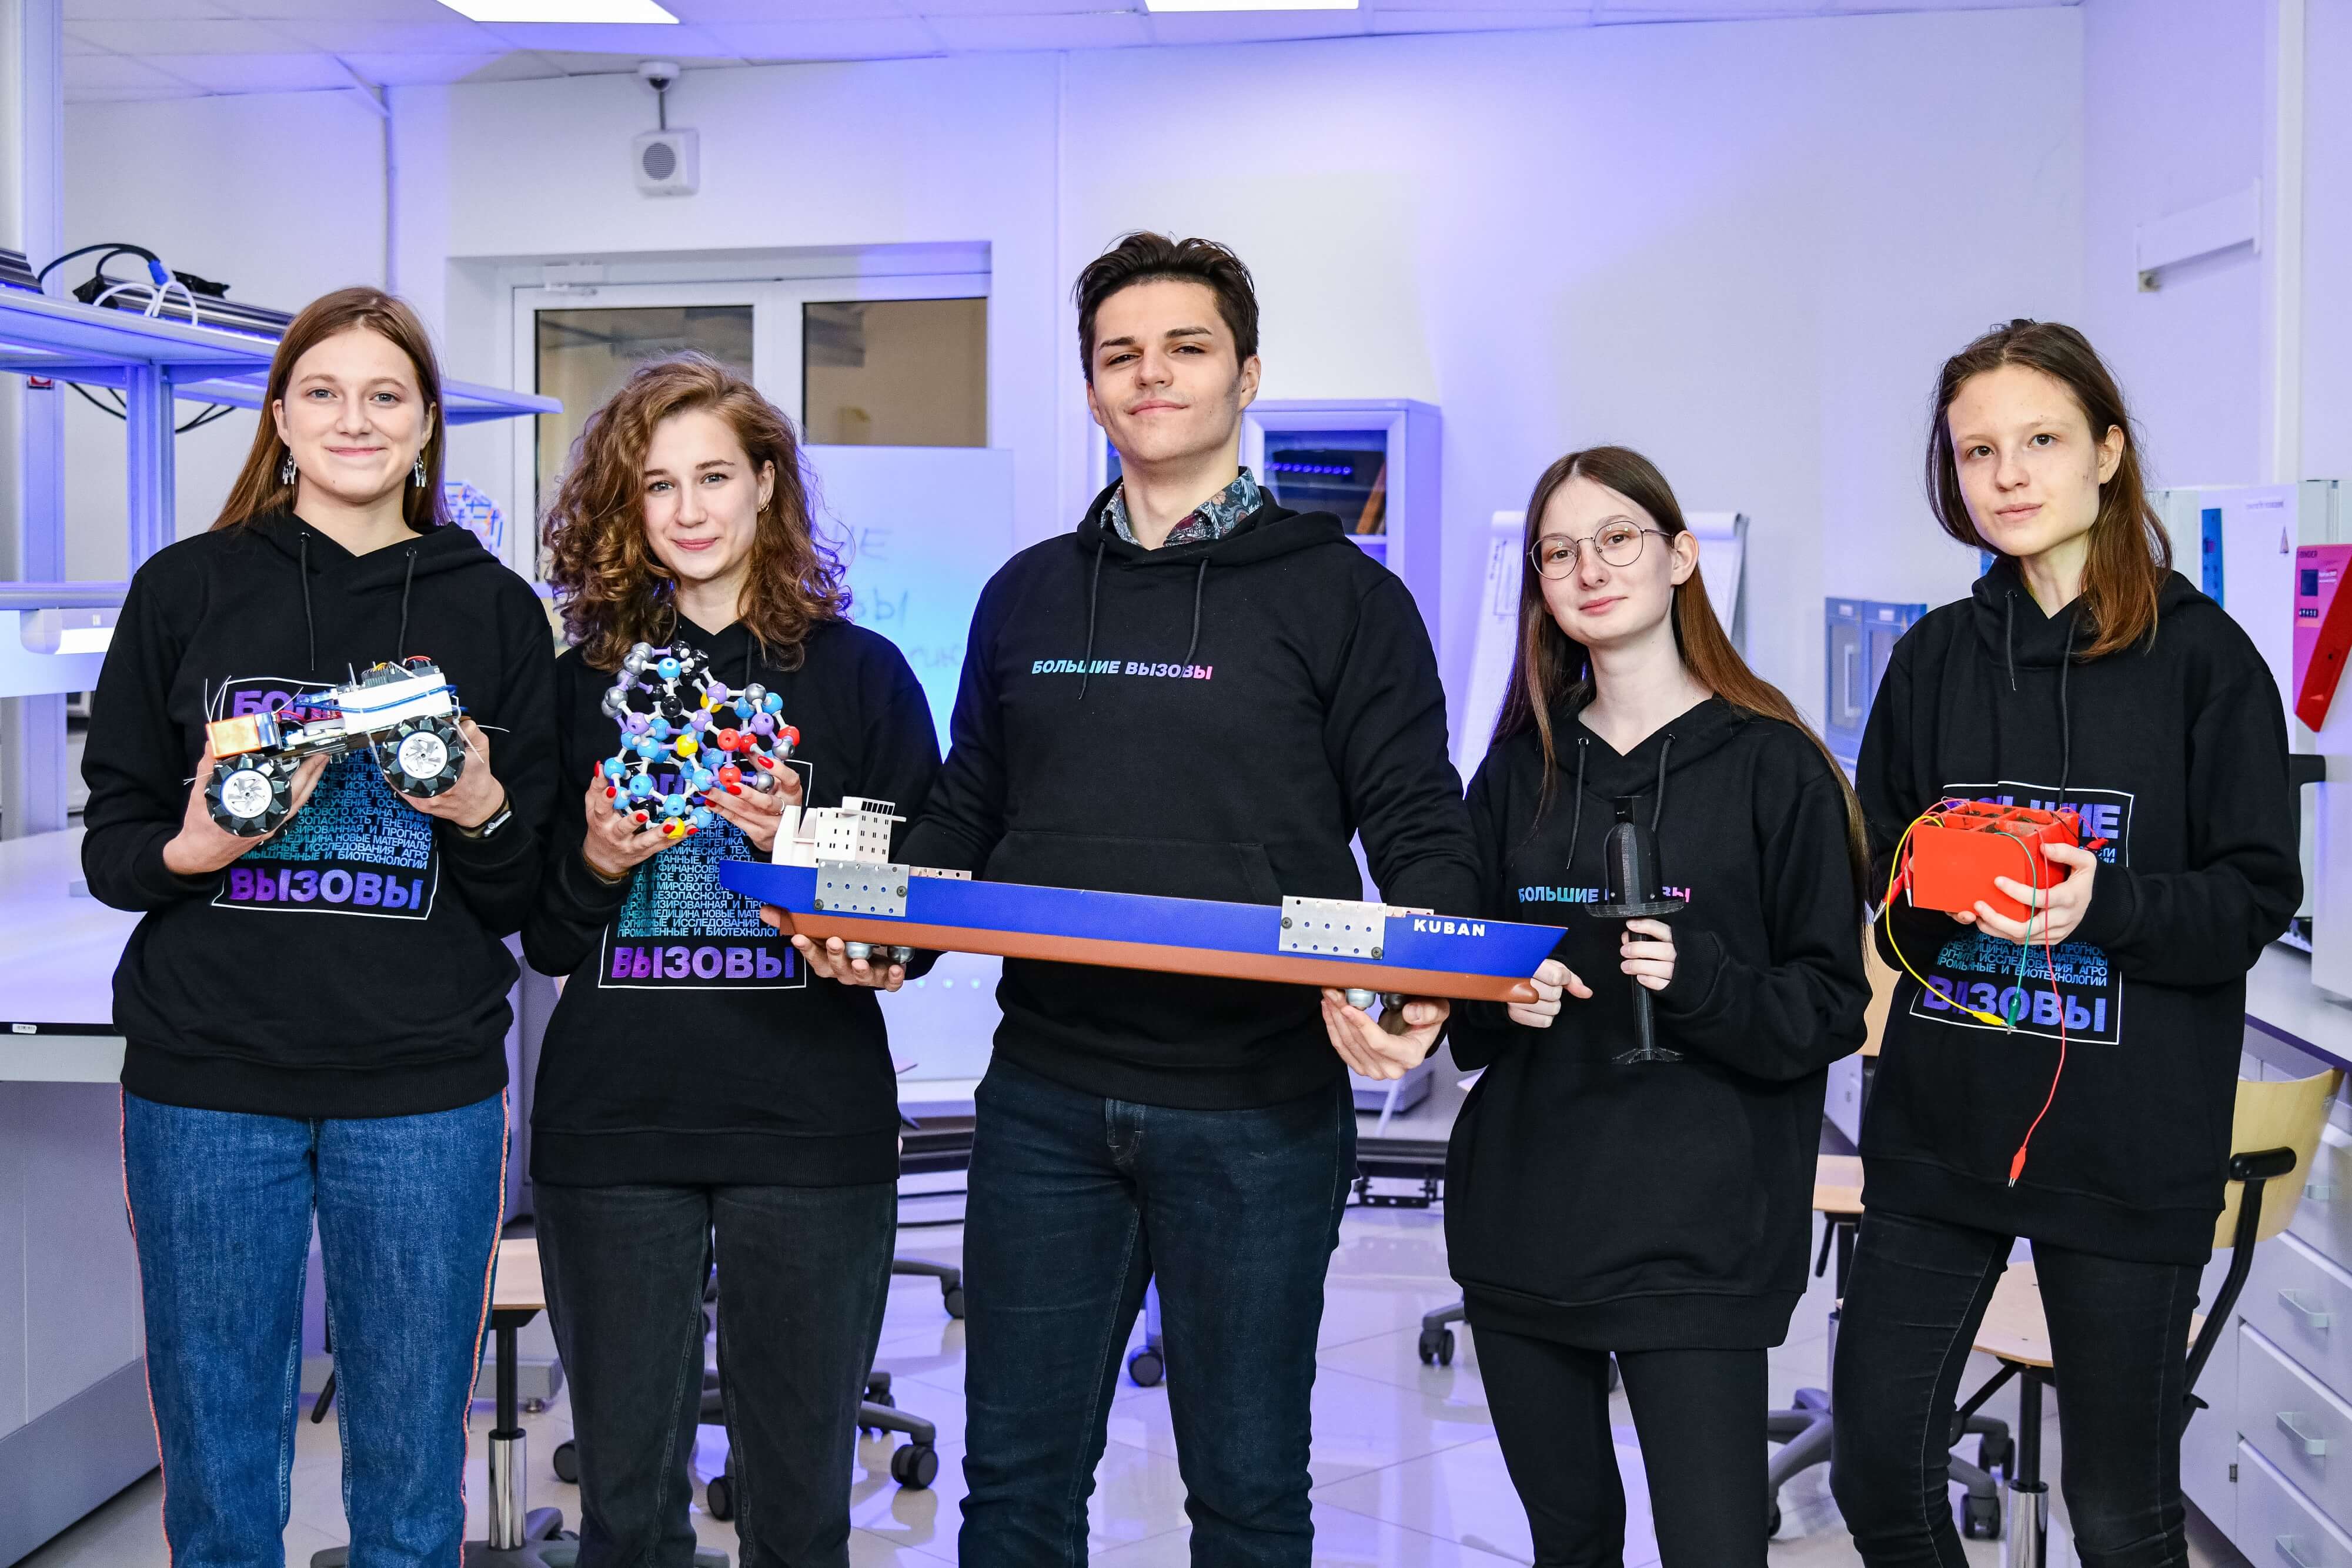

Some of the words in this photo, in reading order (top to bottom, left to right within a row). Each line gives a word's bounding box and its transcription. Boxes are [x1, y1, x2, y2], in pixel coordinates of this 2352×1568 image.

[1031, 660, 1121, 674] БОЛЬШИЕ
[1125, 662, 1213, 680] ВЫЗОВЫ
[315, 798, 372, 807] ОБУЧЕНИЕ
[299, 807, 349, 816] ИРОВОГО
[352, 807, 393, 818] ОКЕАНА
[298, 816, 372, 824] ЗОПАСНОСТЬ
[292, 824, 363, 834] ЗИРОВАННАЯ
[370, 825, 377, 834] И
[383, 827, 432, 841] ПРОГНОС
[336, 833, 370, 843] НОВЫЕ
[373, 835, 431, 851] МАТЕРИАЛЫ
[681, 837, 744, 847] ЭНЕРГЕТИКА
[305, 842, 395, 855] ИССЛЕДОВАНИЯ
[401, 848, 429, 860] АГРО
[325, 851, 332, 860] И
[338, 851, 427, 870] БИОТЕХНОЛОГИИ
[230, 868, 424, 910] ВЫЗОВЫ
[656, 882, 713, 891] МИРОВОГО
[653, 890, 734, 900] БЕЗОПАСНОСТЬ
[1518, 886, 1599, 904] БОЛЬШИЕ
[733, 901, 740, 909] И
[702, 909, 735, 918] НОВЫЕ
[673, 918, 760, 927] ИССЛЕДОВАНИЯ
[1414, 919, 1485, 937] KUBAN
[694, 928, 701, 936] И
[612, 947, 794, 978] ВЫЗОВЫ
[2051, 952, 2107, 967] МАТЕРИАЛЫ
[2001, 965, 2009, 974] И
[2079, 966, 2107, 977] АГРО
